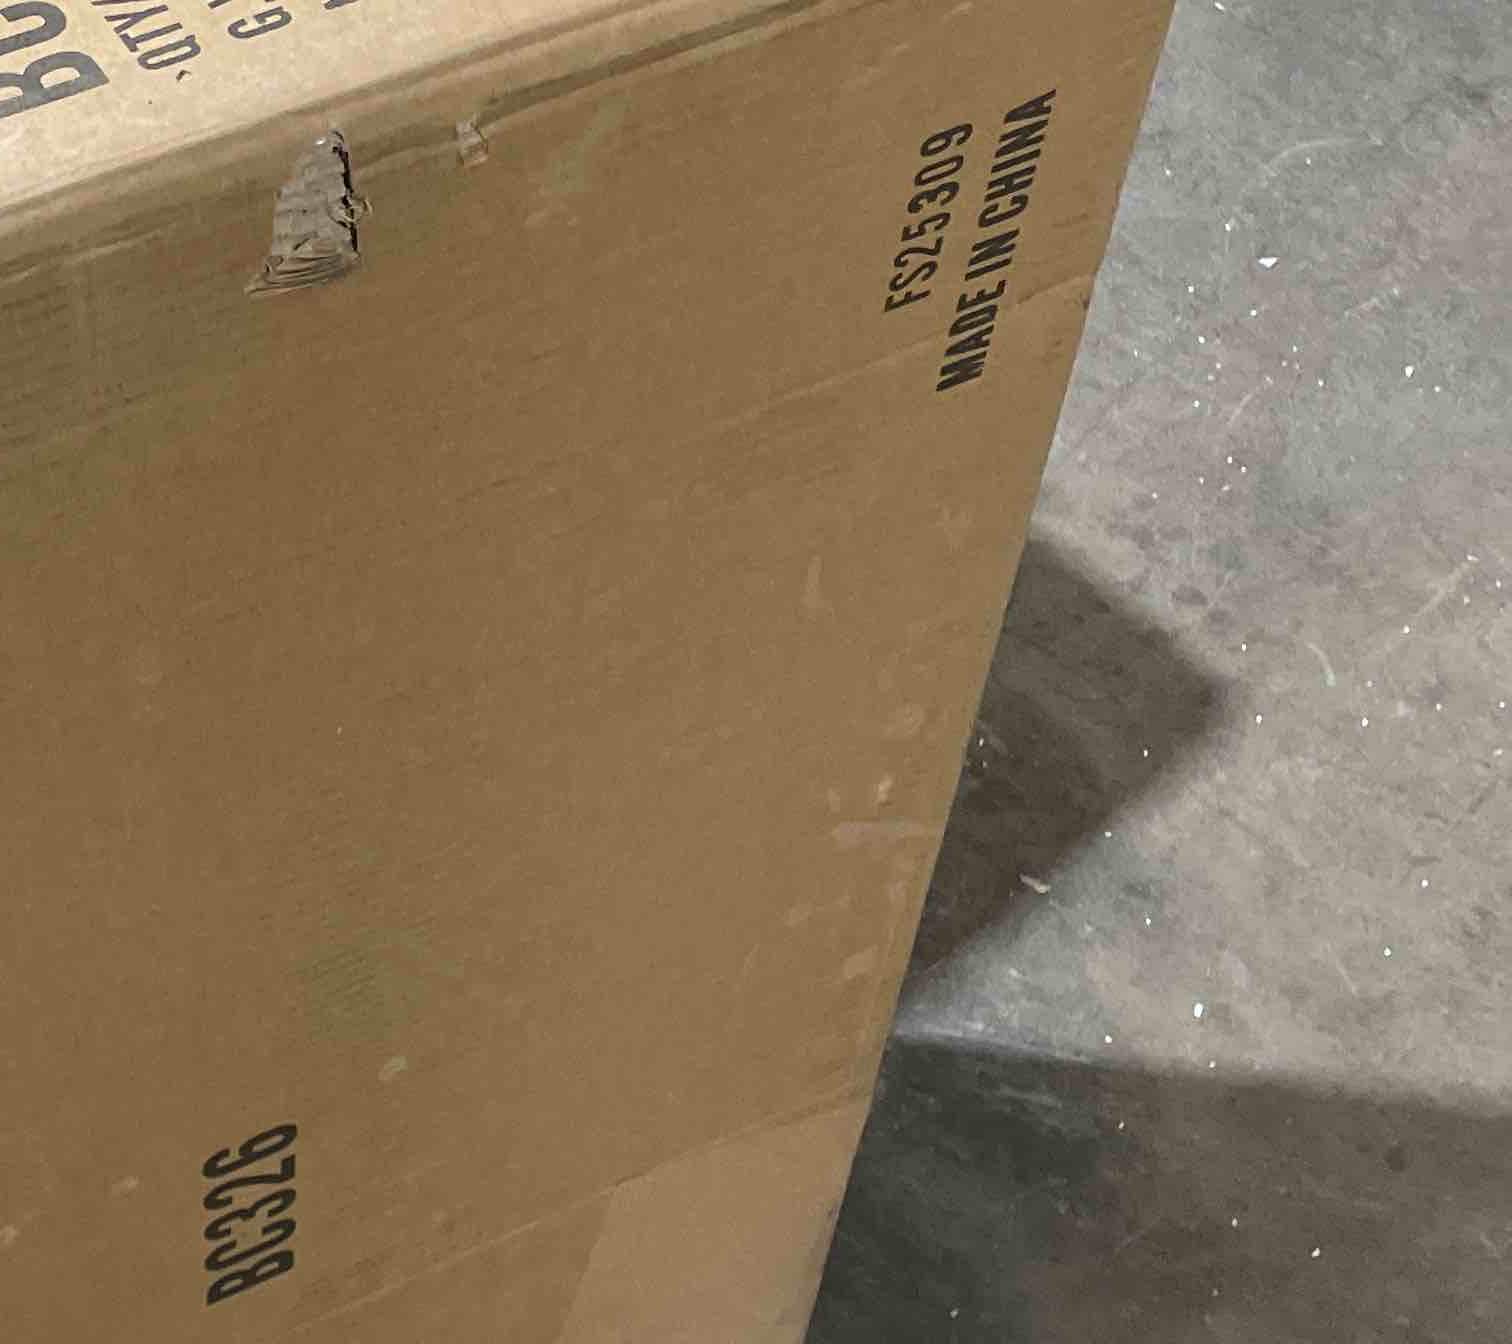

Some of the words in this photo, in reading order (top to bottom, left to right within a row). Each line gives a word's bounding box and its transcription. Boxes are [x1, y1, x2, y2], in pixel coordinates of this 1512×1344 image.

[882, 122, 974, 313] FS25309
[977, 88, 1057, 229] CHINA
[963, 229, 1020, 282] IN
[935, 278, 1007, 393] MADE
[202, 1122, 298, 1307] BC326
